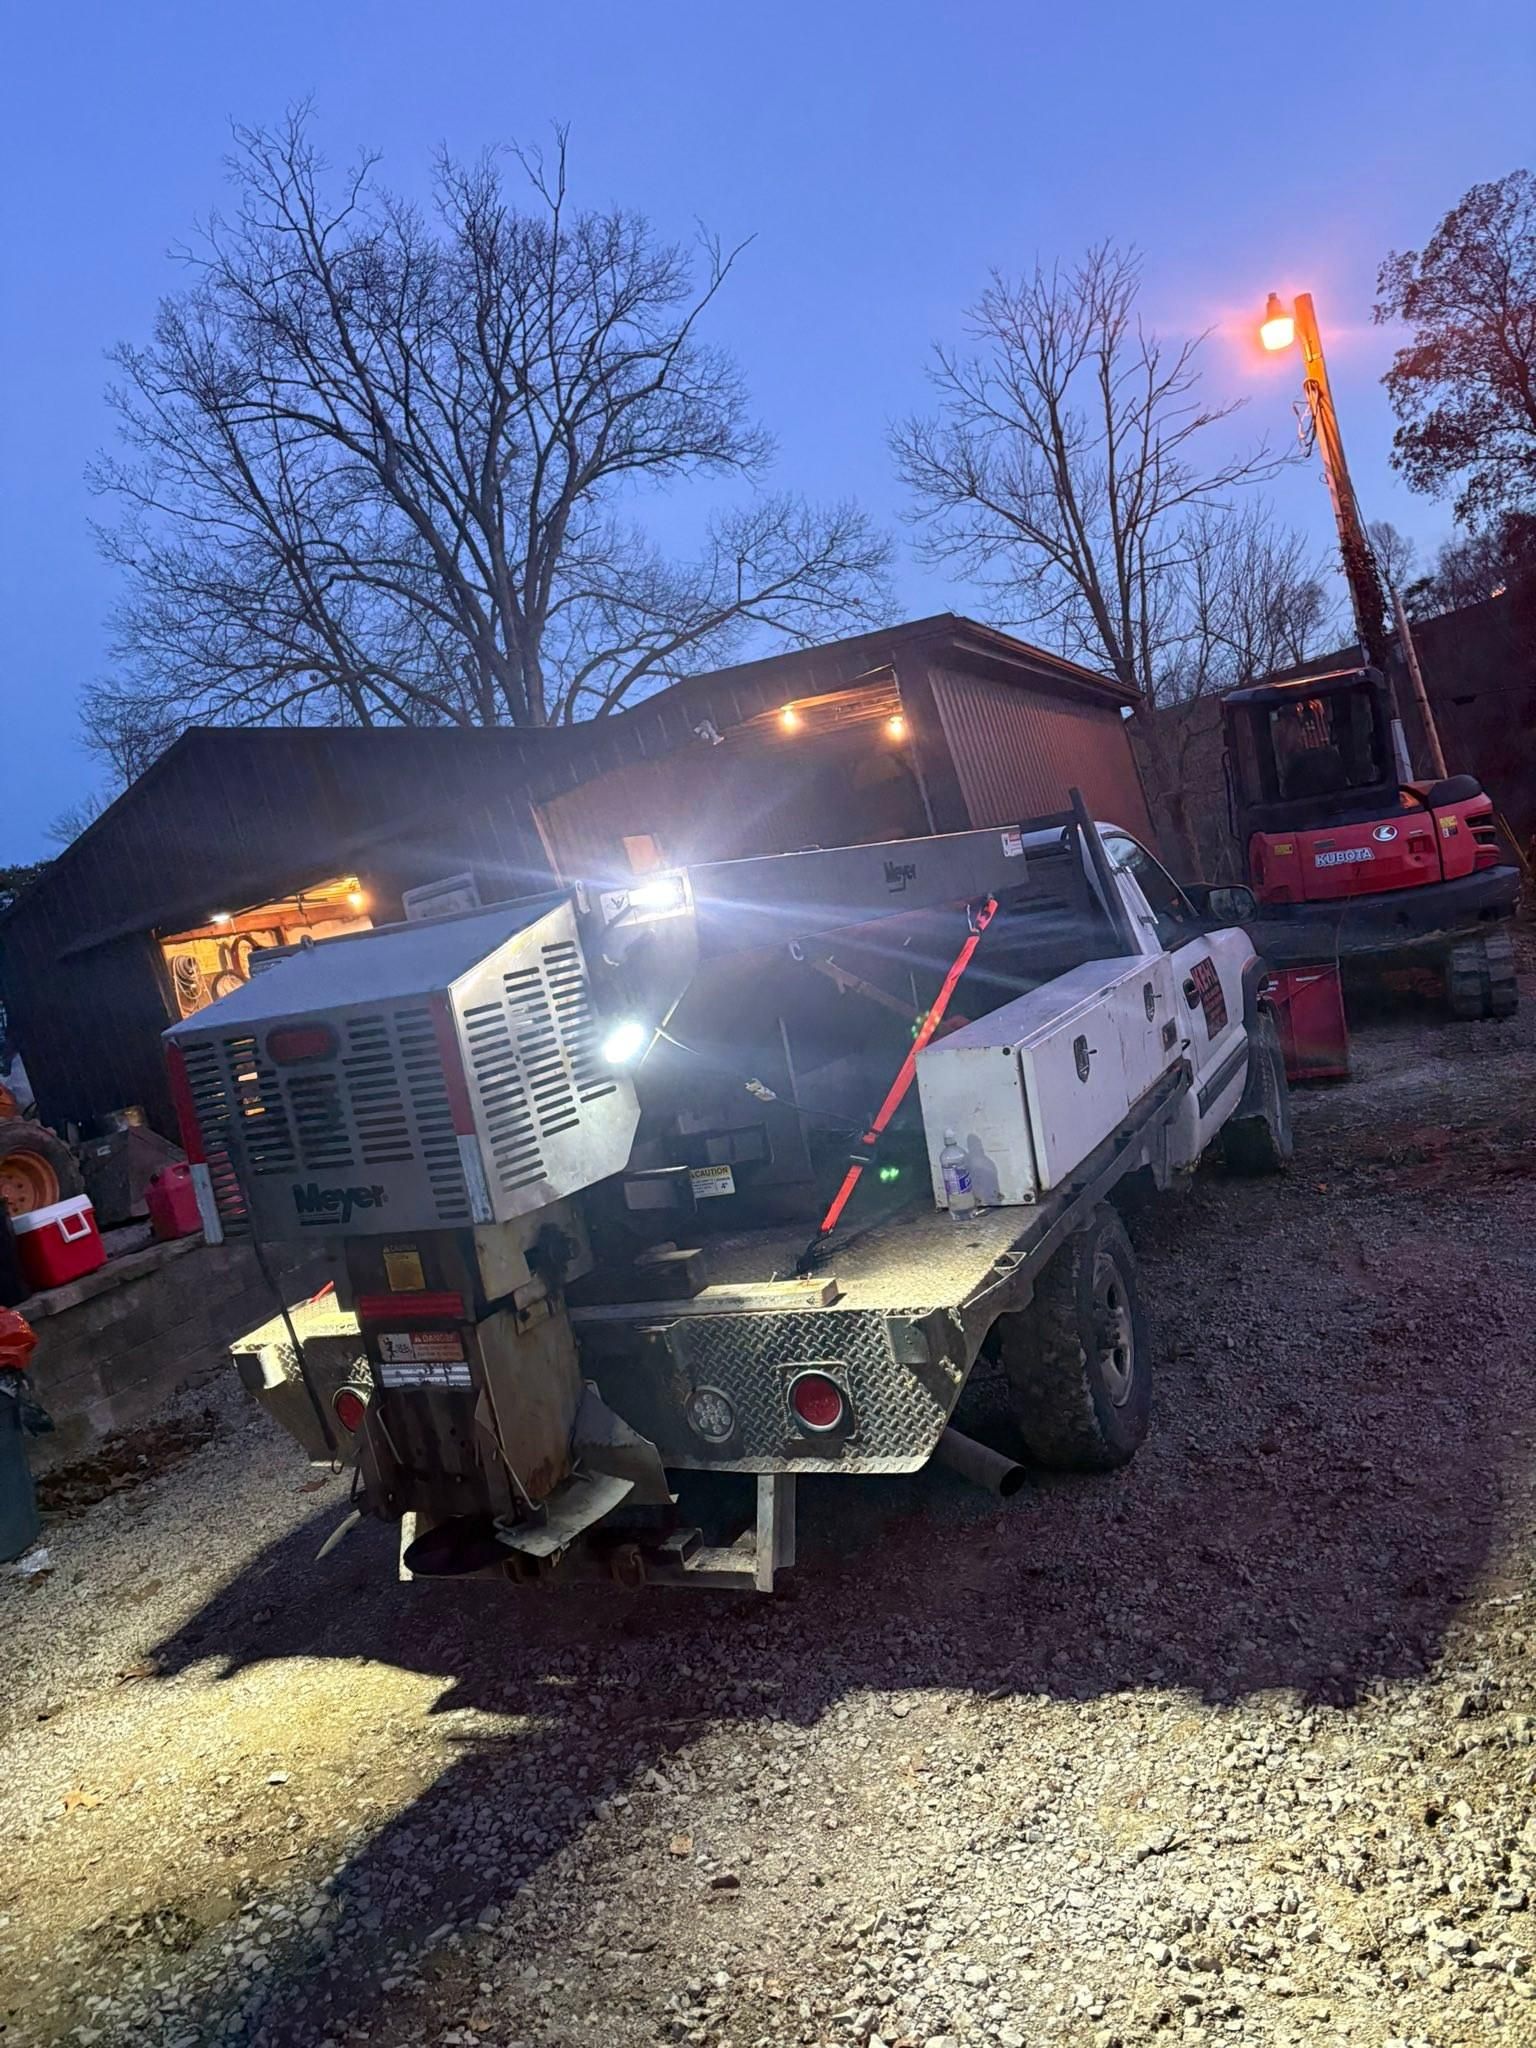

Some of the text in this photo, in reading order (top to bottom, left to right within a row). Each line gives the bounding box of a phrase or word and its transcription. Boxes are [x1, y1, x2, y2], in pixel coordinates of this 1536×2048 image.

[1315, 847, 1375, 868] KUBOTA
[884, 861, 917, 891] Meyer
[694, 1166, 729, 1178] CAUTION
[292, 1183, 384, 1225] Meyer
